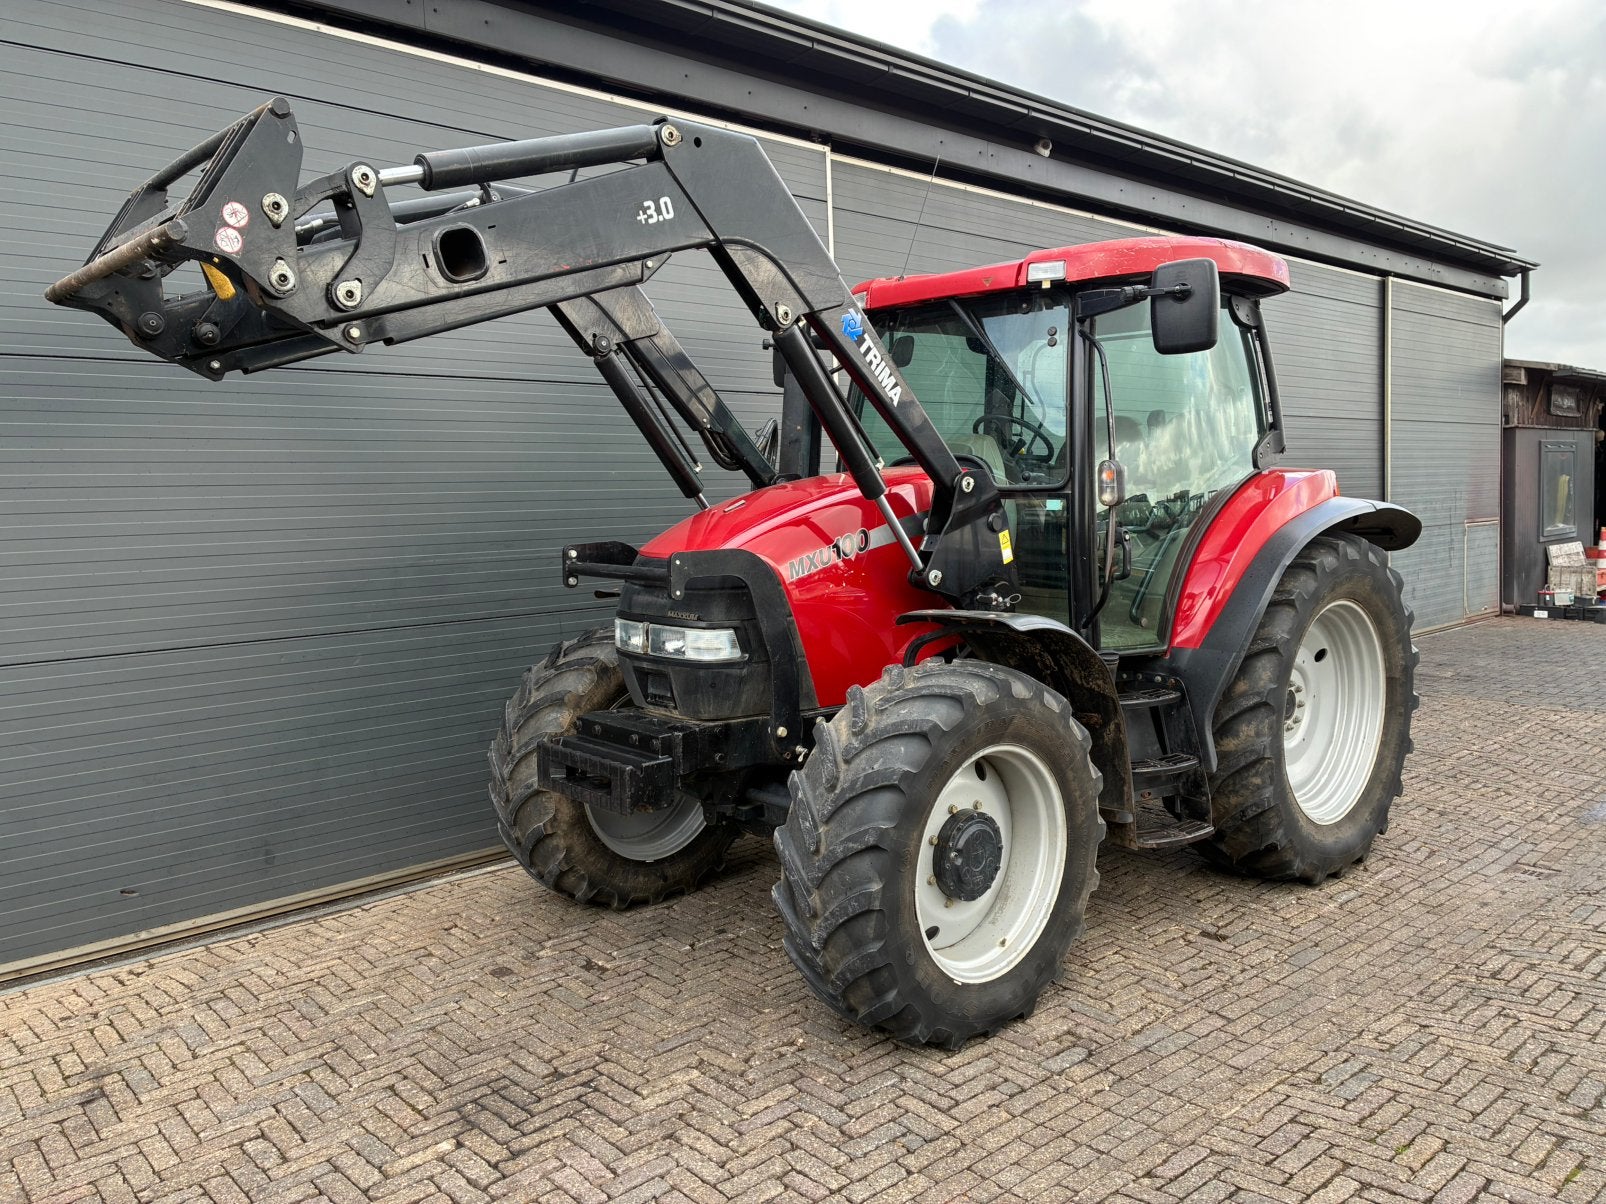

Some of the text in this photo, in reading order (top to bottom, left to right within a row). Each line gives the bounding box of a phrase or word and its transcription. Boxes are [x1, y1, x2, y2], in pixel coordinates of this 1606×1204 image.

[636, 196, 674, 224] +3.0
[860, 332, 902, 407] TRIMA
[788, 528, 869, 581] MXU100
